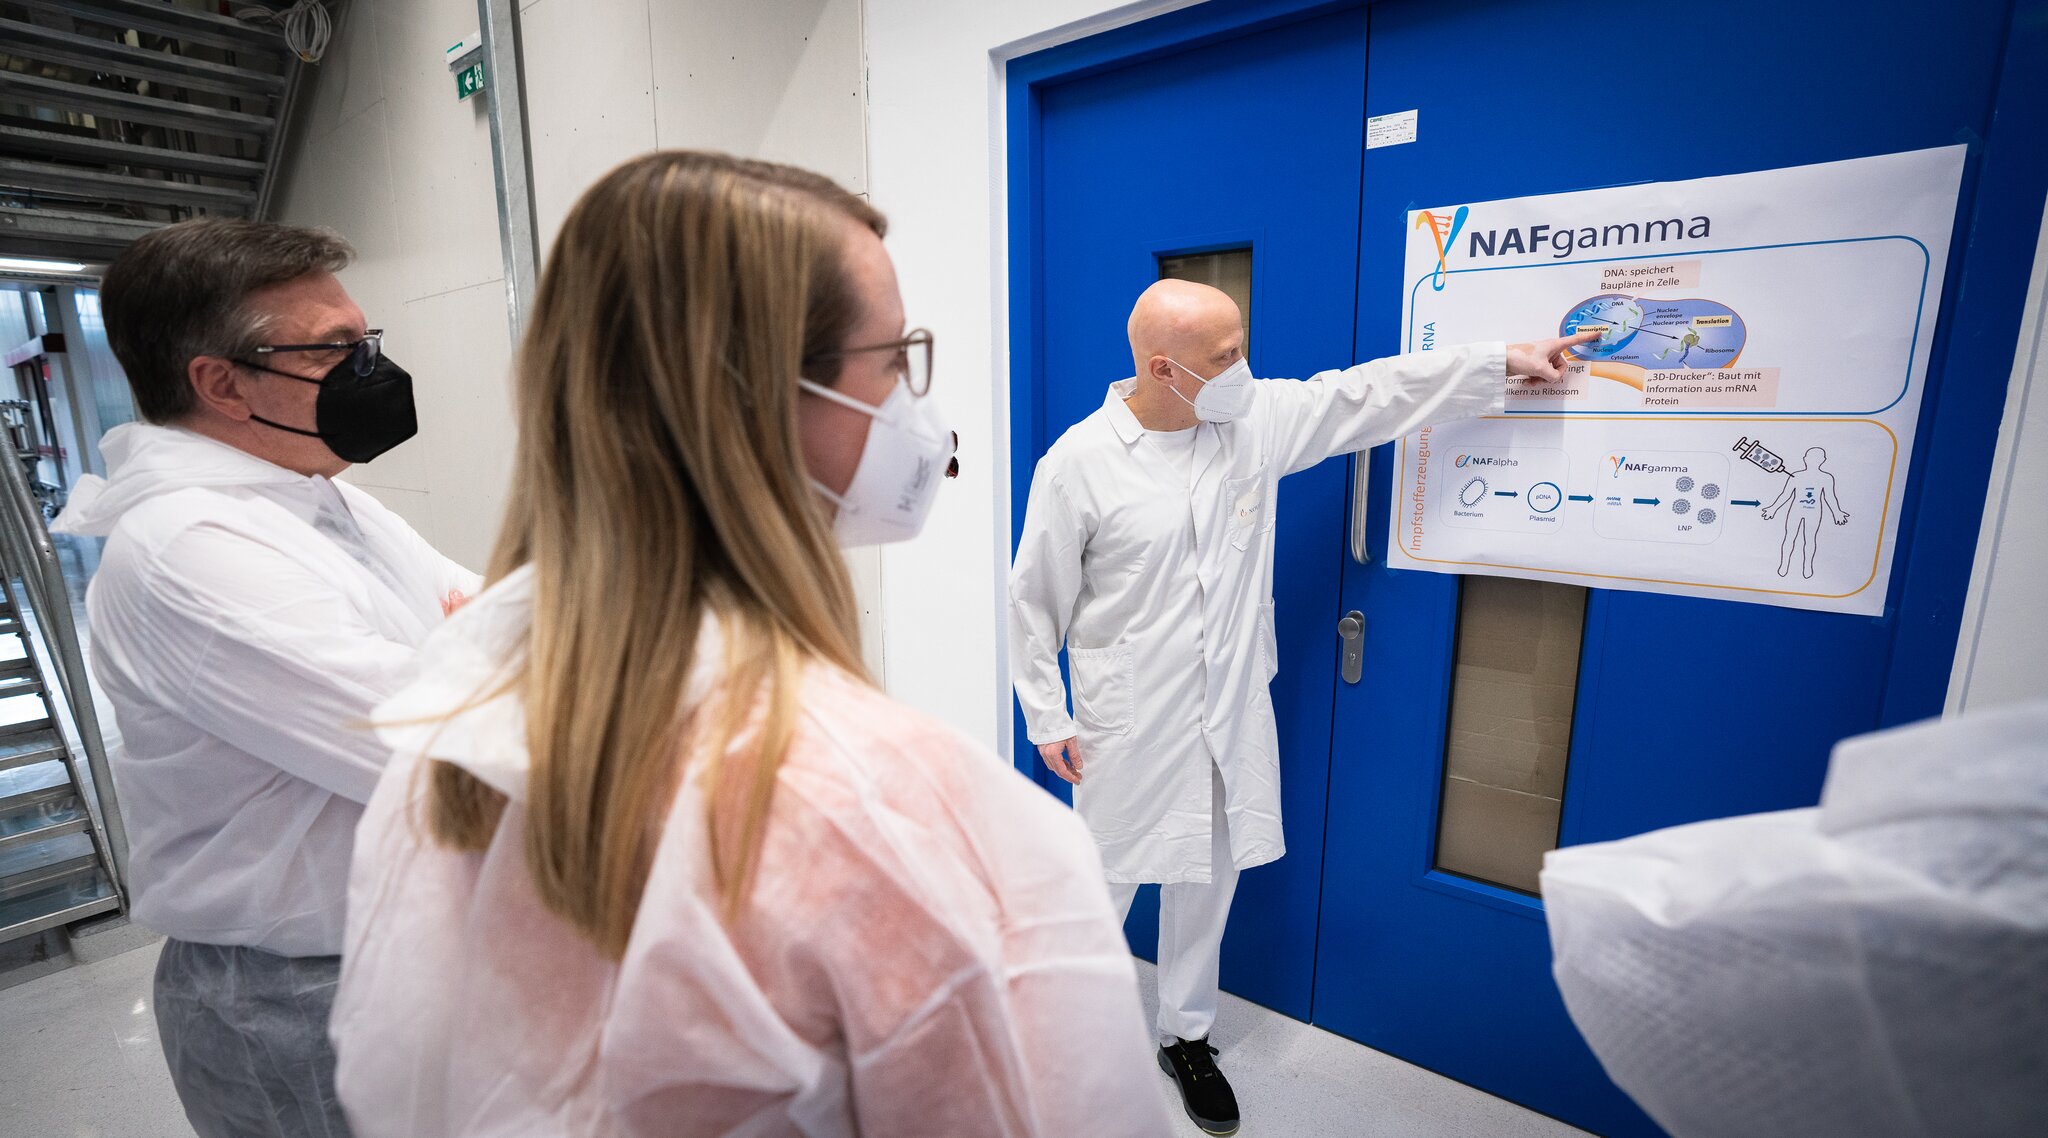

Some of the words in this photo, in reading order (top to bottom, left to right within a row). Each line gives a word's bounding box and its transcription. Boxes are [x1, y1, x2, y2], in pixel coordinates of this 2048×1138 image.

[1469, 215, 1711, 258] NAFgamma
[1604, 268, 1628, 278] DNA:
[1630, 266, 1674, 277] speichert
[1600, 280, 1643, 290] Baupläne
[1646, 279, 1654, 287] in
[1657, 277, 1680, 287] Zelle
[1717, 371, 1741, 381] Baut
[1744, 371, 1762, 380] mit
[1542, 388, 1579, 396] Ribosom
[1646, 385, 1702, 393] Information
[1725, 384, 1757, 393] mRNA
[1645, 397, 1679, 405] Protein
[1472, 457, 1519, 468] NAFalpha
[1625, 463, 1688, 474] NAFgamma
[1410, 425, 1432, 550] Impfstofferzeugung
[1454, 510, 1484, 518] Bacterium
[1529, 515, 1556, 523] Plasmid
